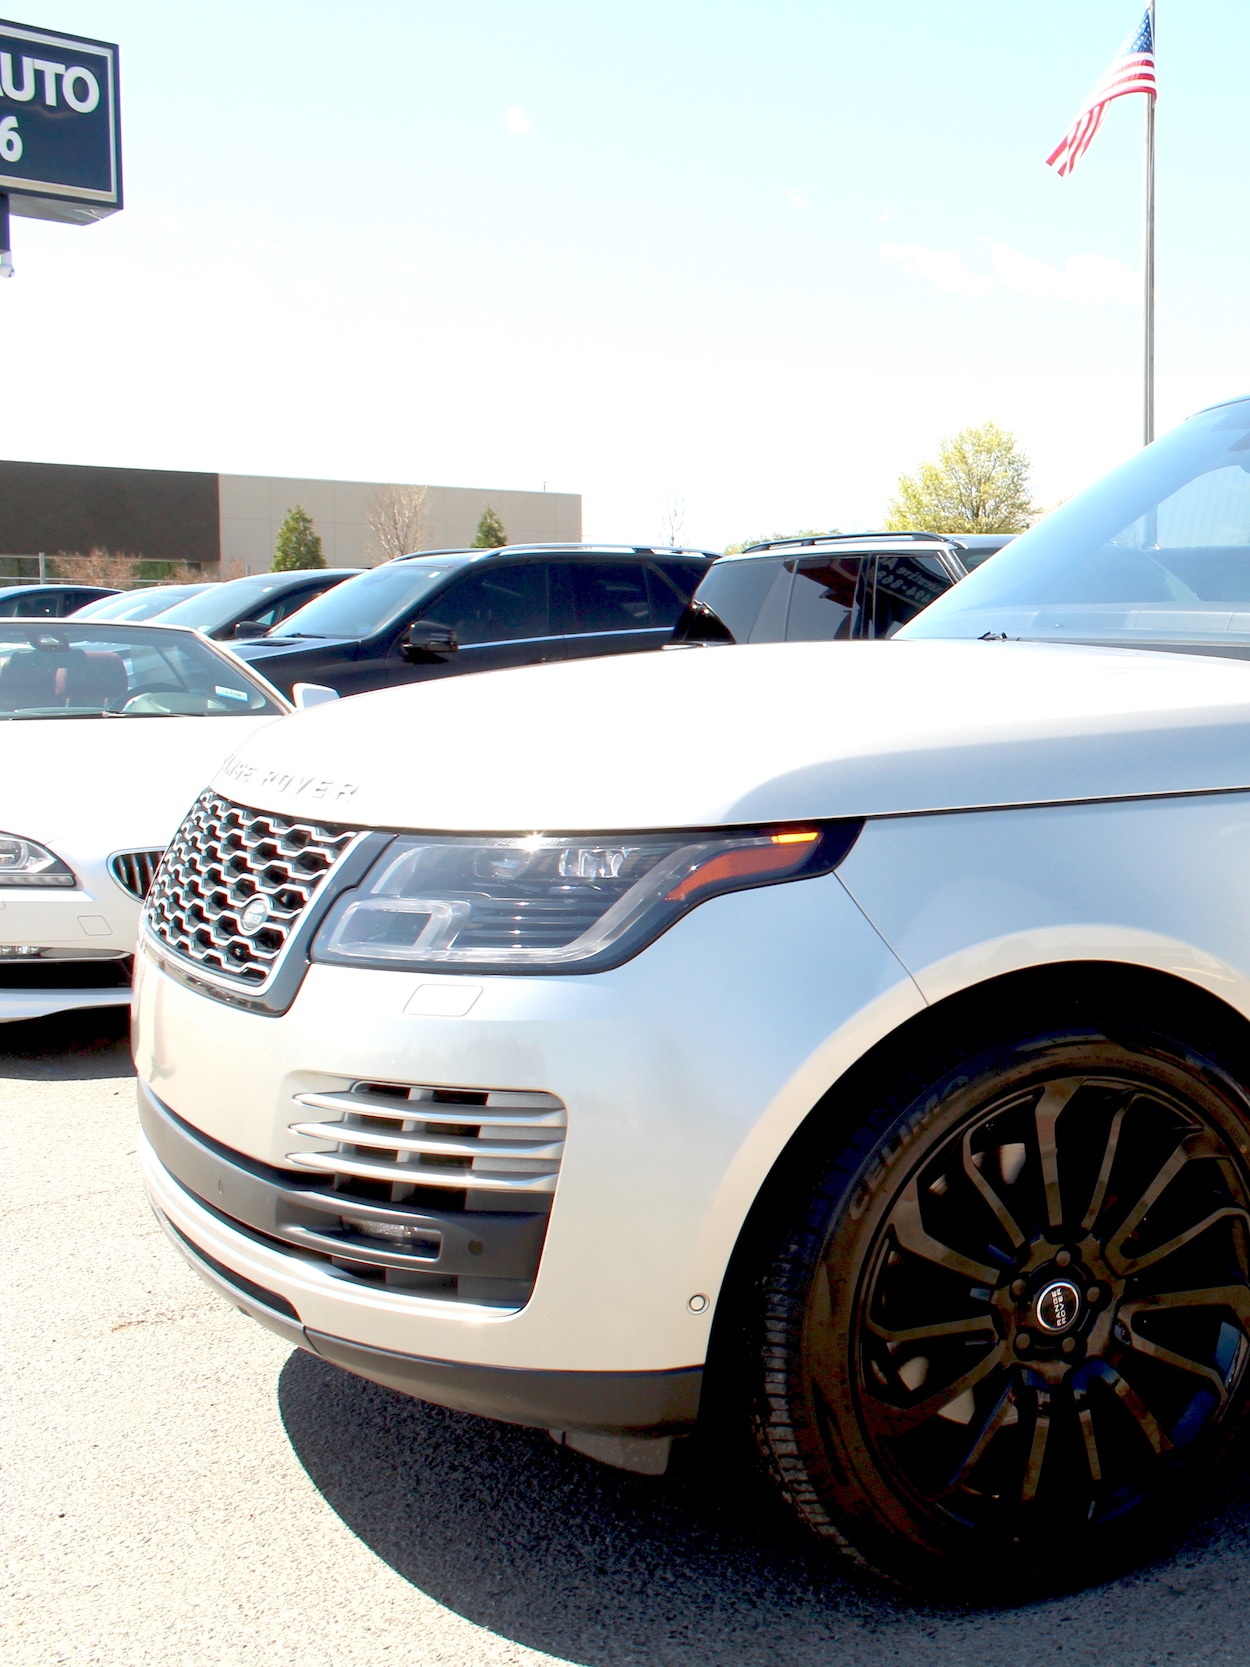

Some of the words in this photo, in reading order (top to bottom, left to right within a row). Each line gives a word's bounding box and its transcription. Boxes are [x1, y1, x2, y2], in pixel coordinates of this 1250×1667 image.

[0, 52, 100, 114] UTO
[261, 770, 362, 802] ROVER
[1051, 1290, 1062, 1327] RANGE
[1056, 1287, 1067, 1325] ROVER
